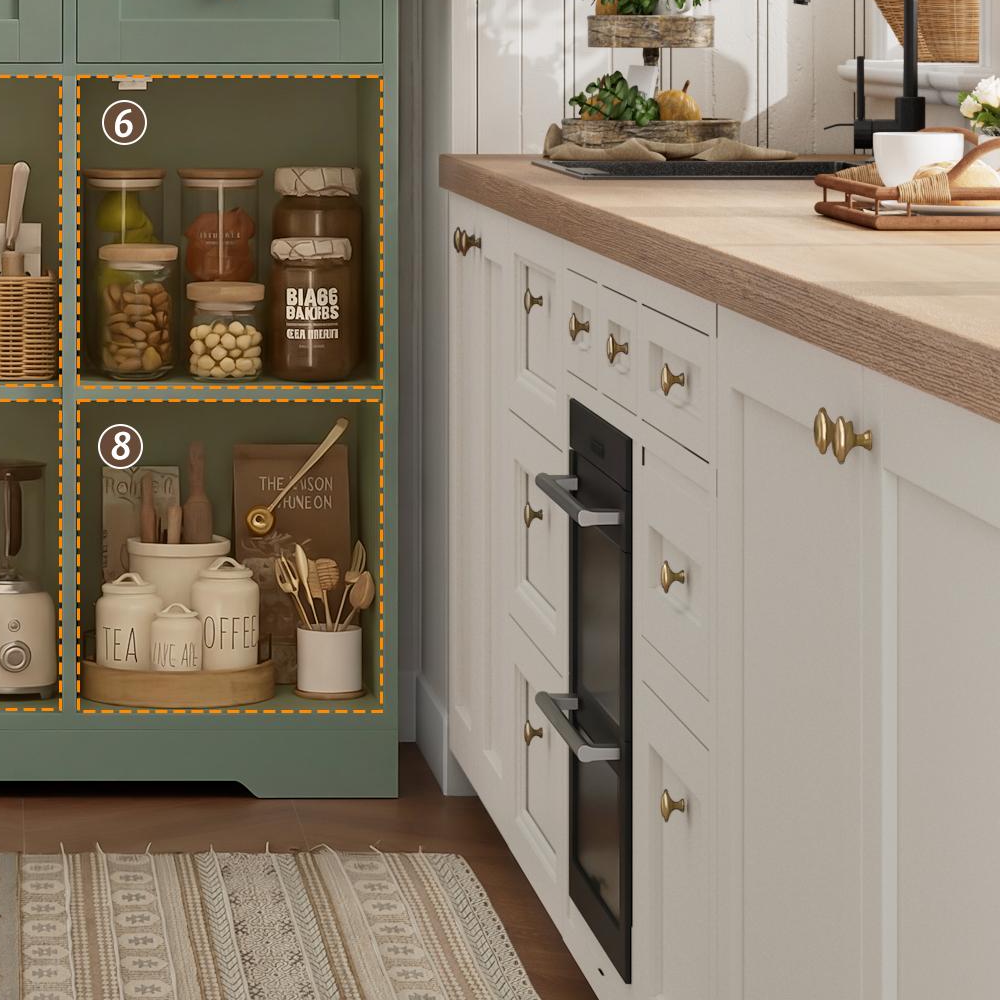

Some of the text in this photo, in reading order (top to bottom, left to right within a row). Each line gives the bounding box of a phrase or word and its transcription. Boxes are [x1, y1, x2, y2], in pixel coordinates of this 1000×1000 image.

[258, 476, 285, 491] THE
[103, 626, 138, 663] TEA
[203, 615, 257, 650] OFFEE
